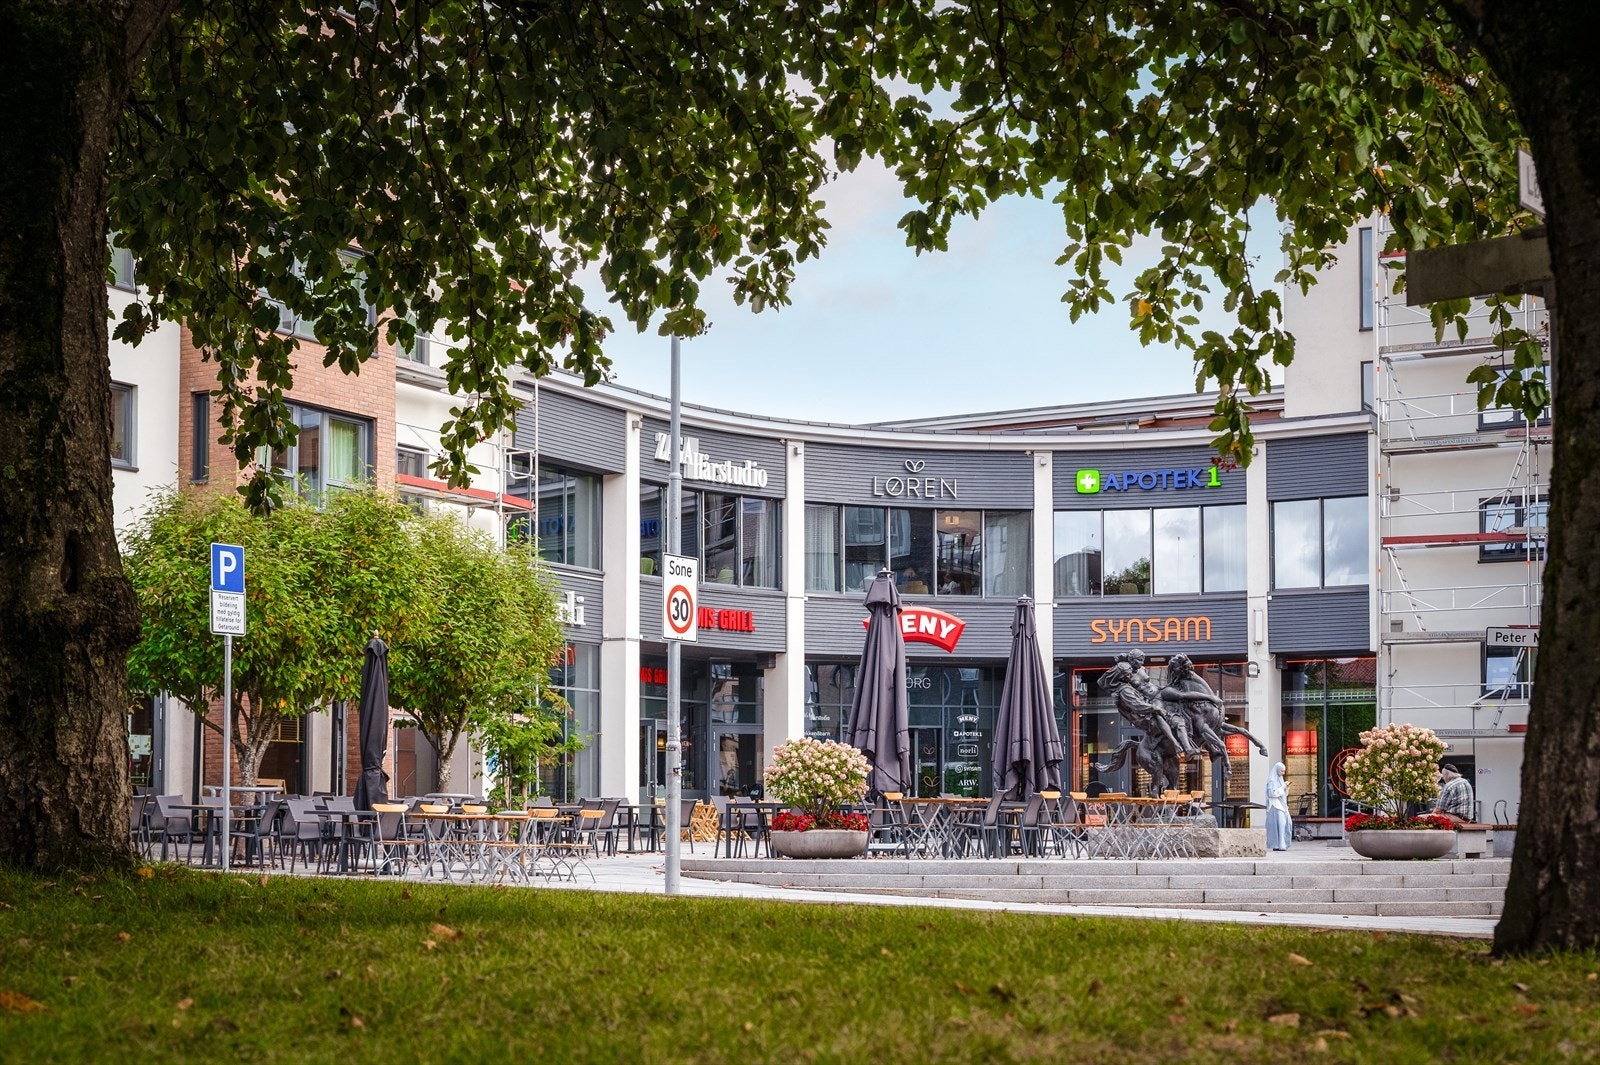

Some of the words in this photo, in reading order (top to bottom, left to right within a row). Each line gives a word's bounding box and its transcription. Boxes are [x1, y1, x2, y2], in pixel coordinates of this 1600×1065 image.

[690, 452, 768, 488] Hårstudio
[1103, 468, 1205, 492] APOTEK
[1207, 466, 1222, 487] 1
[873, 476, 957, 499] LØREN
[219, 550, 237, 586] P
[669, 560, 692, 578] Sone
[219, 602, 238, 610] bildeling
[227, 610, 241, 618] gyldig
[672, 597, 689, 621] 30
[218, 623, 240, 631] Getaround
[718, 609, 756, 633] GRILL
[901, 613, 957, 640] ENY
[1091, 616, 1211, 643] SYNSAM
[1495, 631, 1527, 643] Peter
[959, 715, 978, 723] MENY
[960, 746, 976, 754] norli
